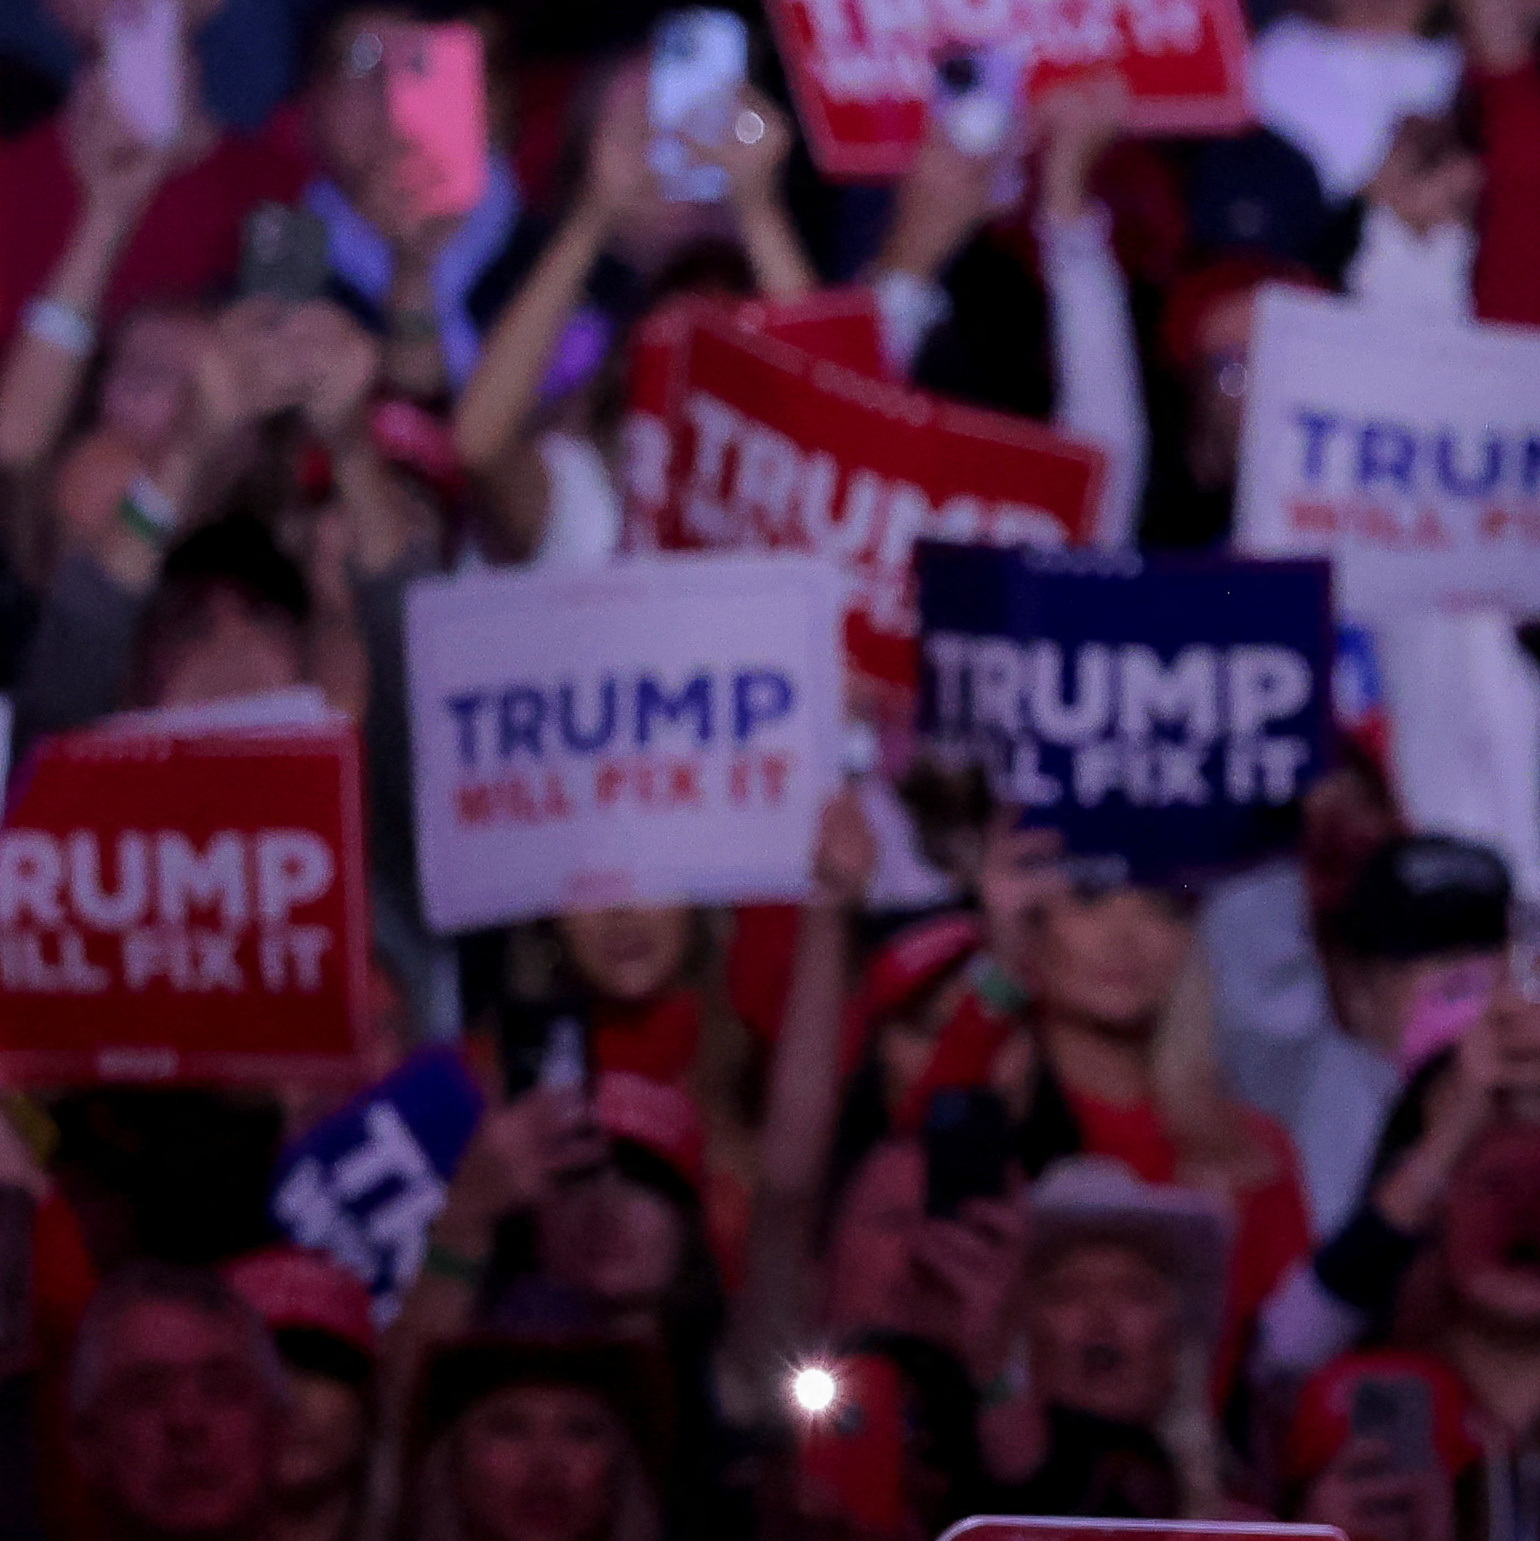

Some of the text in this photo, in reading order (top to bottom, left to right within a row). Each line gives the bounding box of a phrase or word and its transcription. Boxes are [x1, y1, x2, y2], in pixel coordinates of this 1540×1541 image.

[446, 666, 798, 768] TRUMP
[920, 628, 1317, 748] TRUMP
[1070, 736, 1216, 811] FIX
[1220, 732, 1316, 811] IT
[0, 824, 338, 936] RUMP
[0, 920, 336, 996] ILL FIX IT
